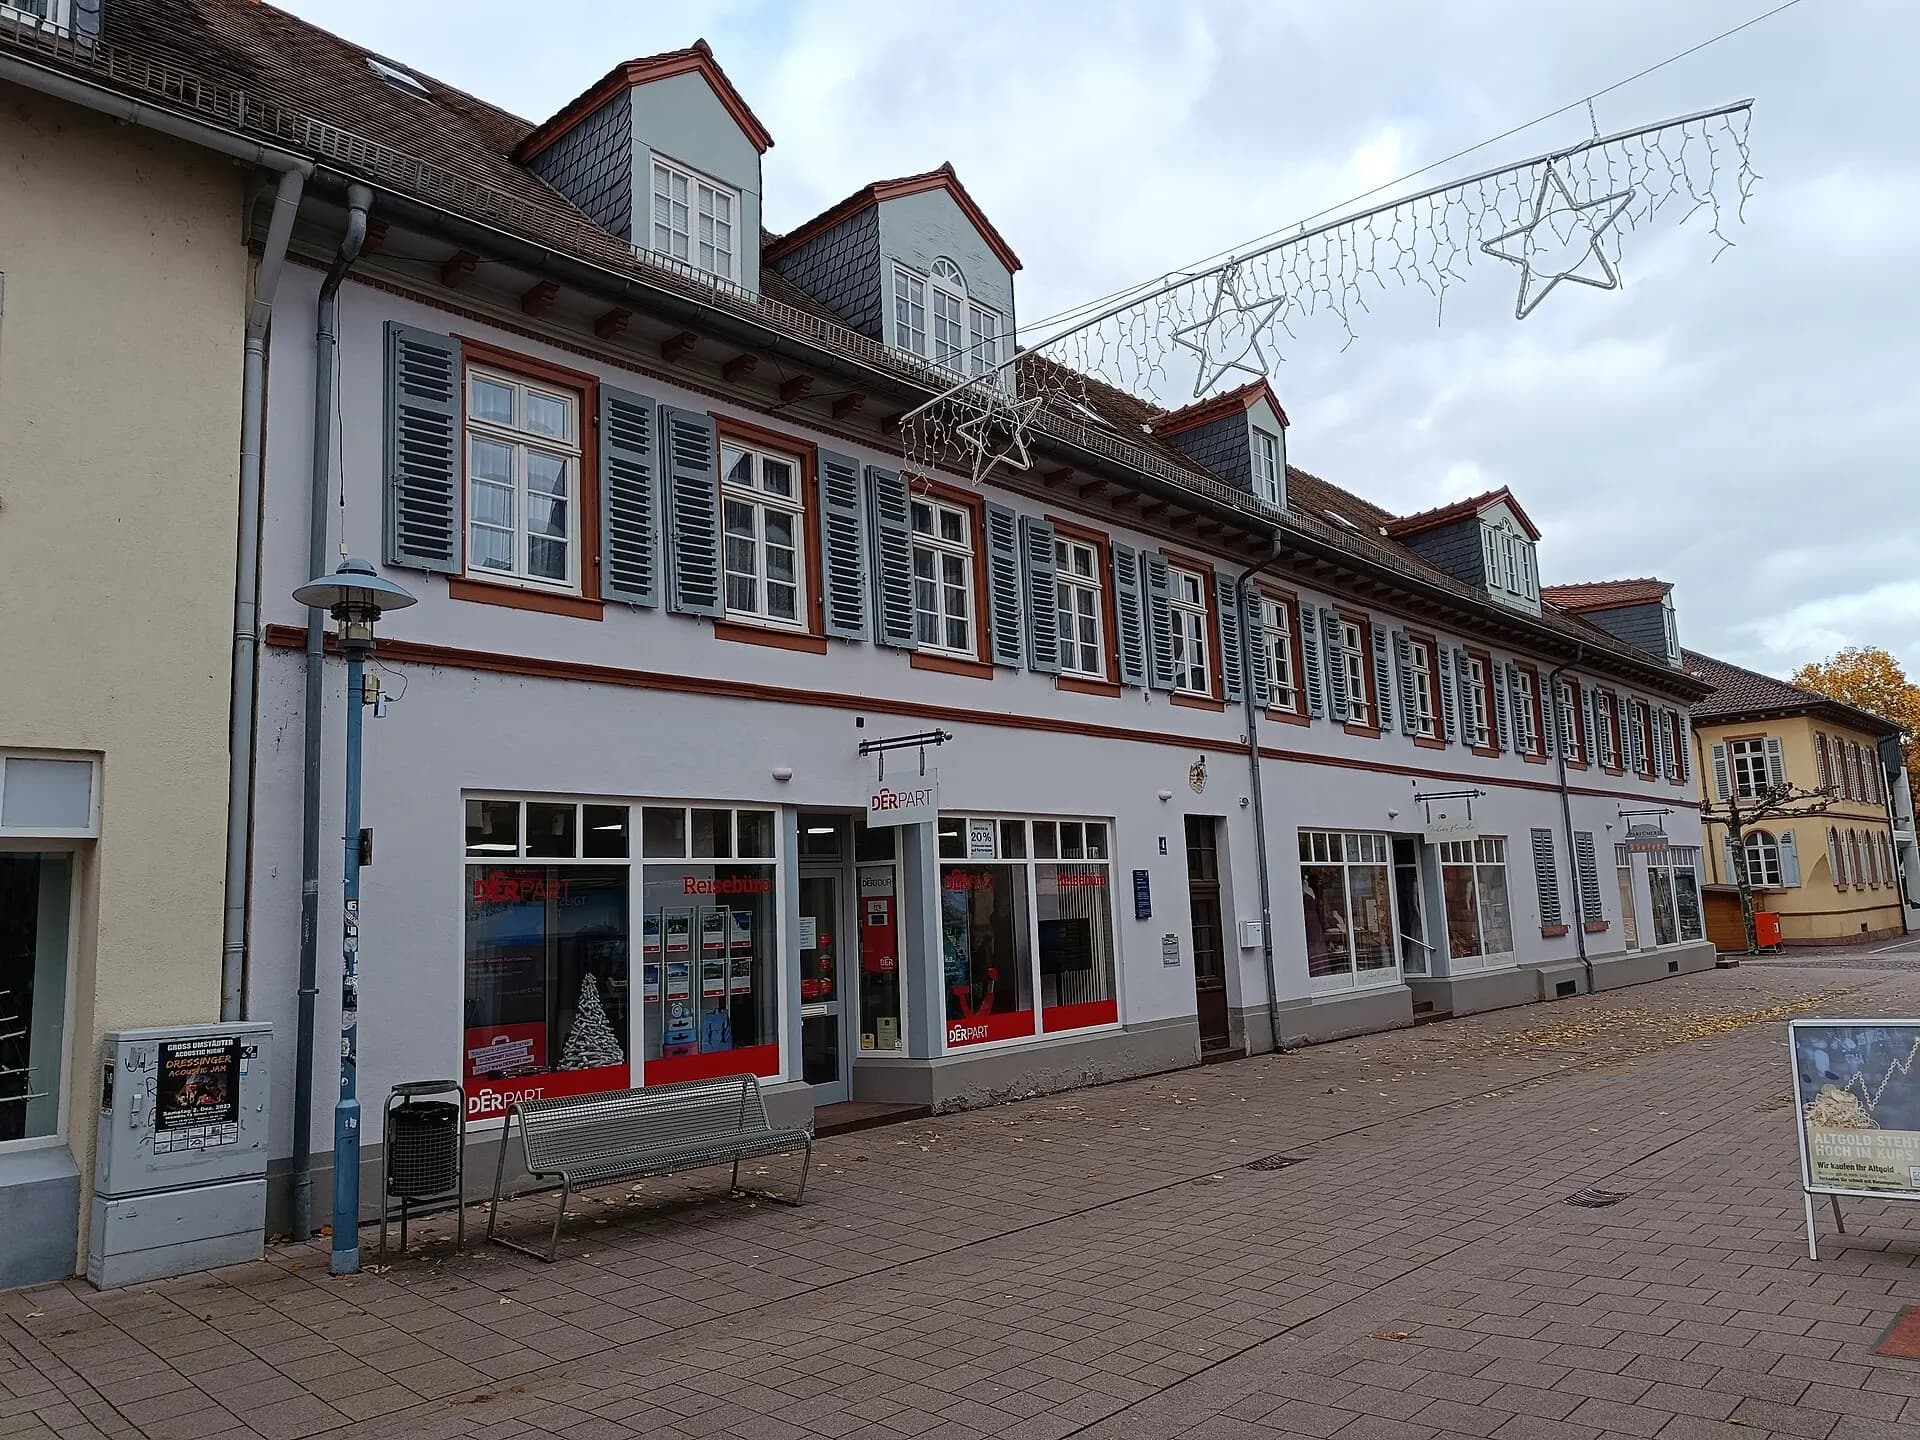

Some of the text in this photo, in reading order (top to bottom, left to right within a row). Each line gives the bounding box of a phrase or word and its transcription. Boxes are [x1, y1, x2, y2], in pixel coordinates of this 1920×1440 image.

[871, 788, 933, 811] DERPART
[971, 831, 992, 842] 20%
[683, 874, 771, 895] Reisebüro
[880, 956, 894, 967] DER
[949, 1024, 988, 1042] DERPART
[166, 1055, 232, 1069] DRESSINGER
[168, 1066, 208, 1077] ACOUSTIC
[468, 1088, 545, 1114] DERPART
[1815, 1133, 1920, 1148] ALTGOLD STEHT
[1815, 1145, 1914, 1161] HOCH IM KURS
[1830, 1163, 1855, 1171] kaufen
[1868, 1165, 1895, 1173] Altgold
